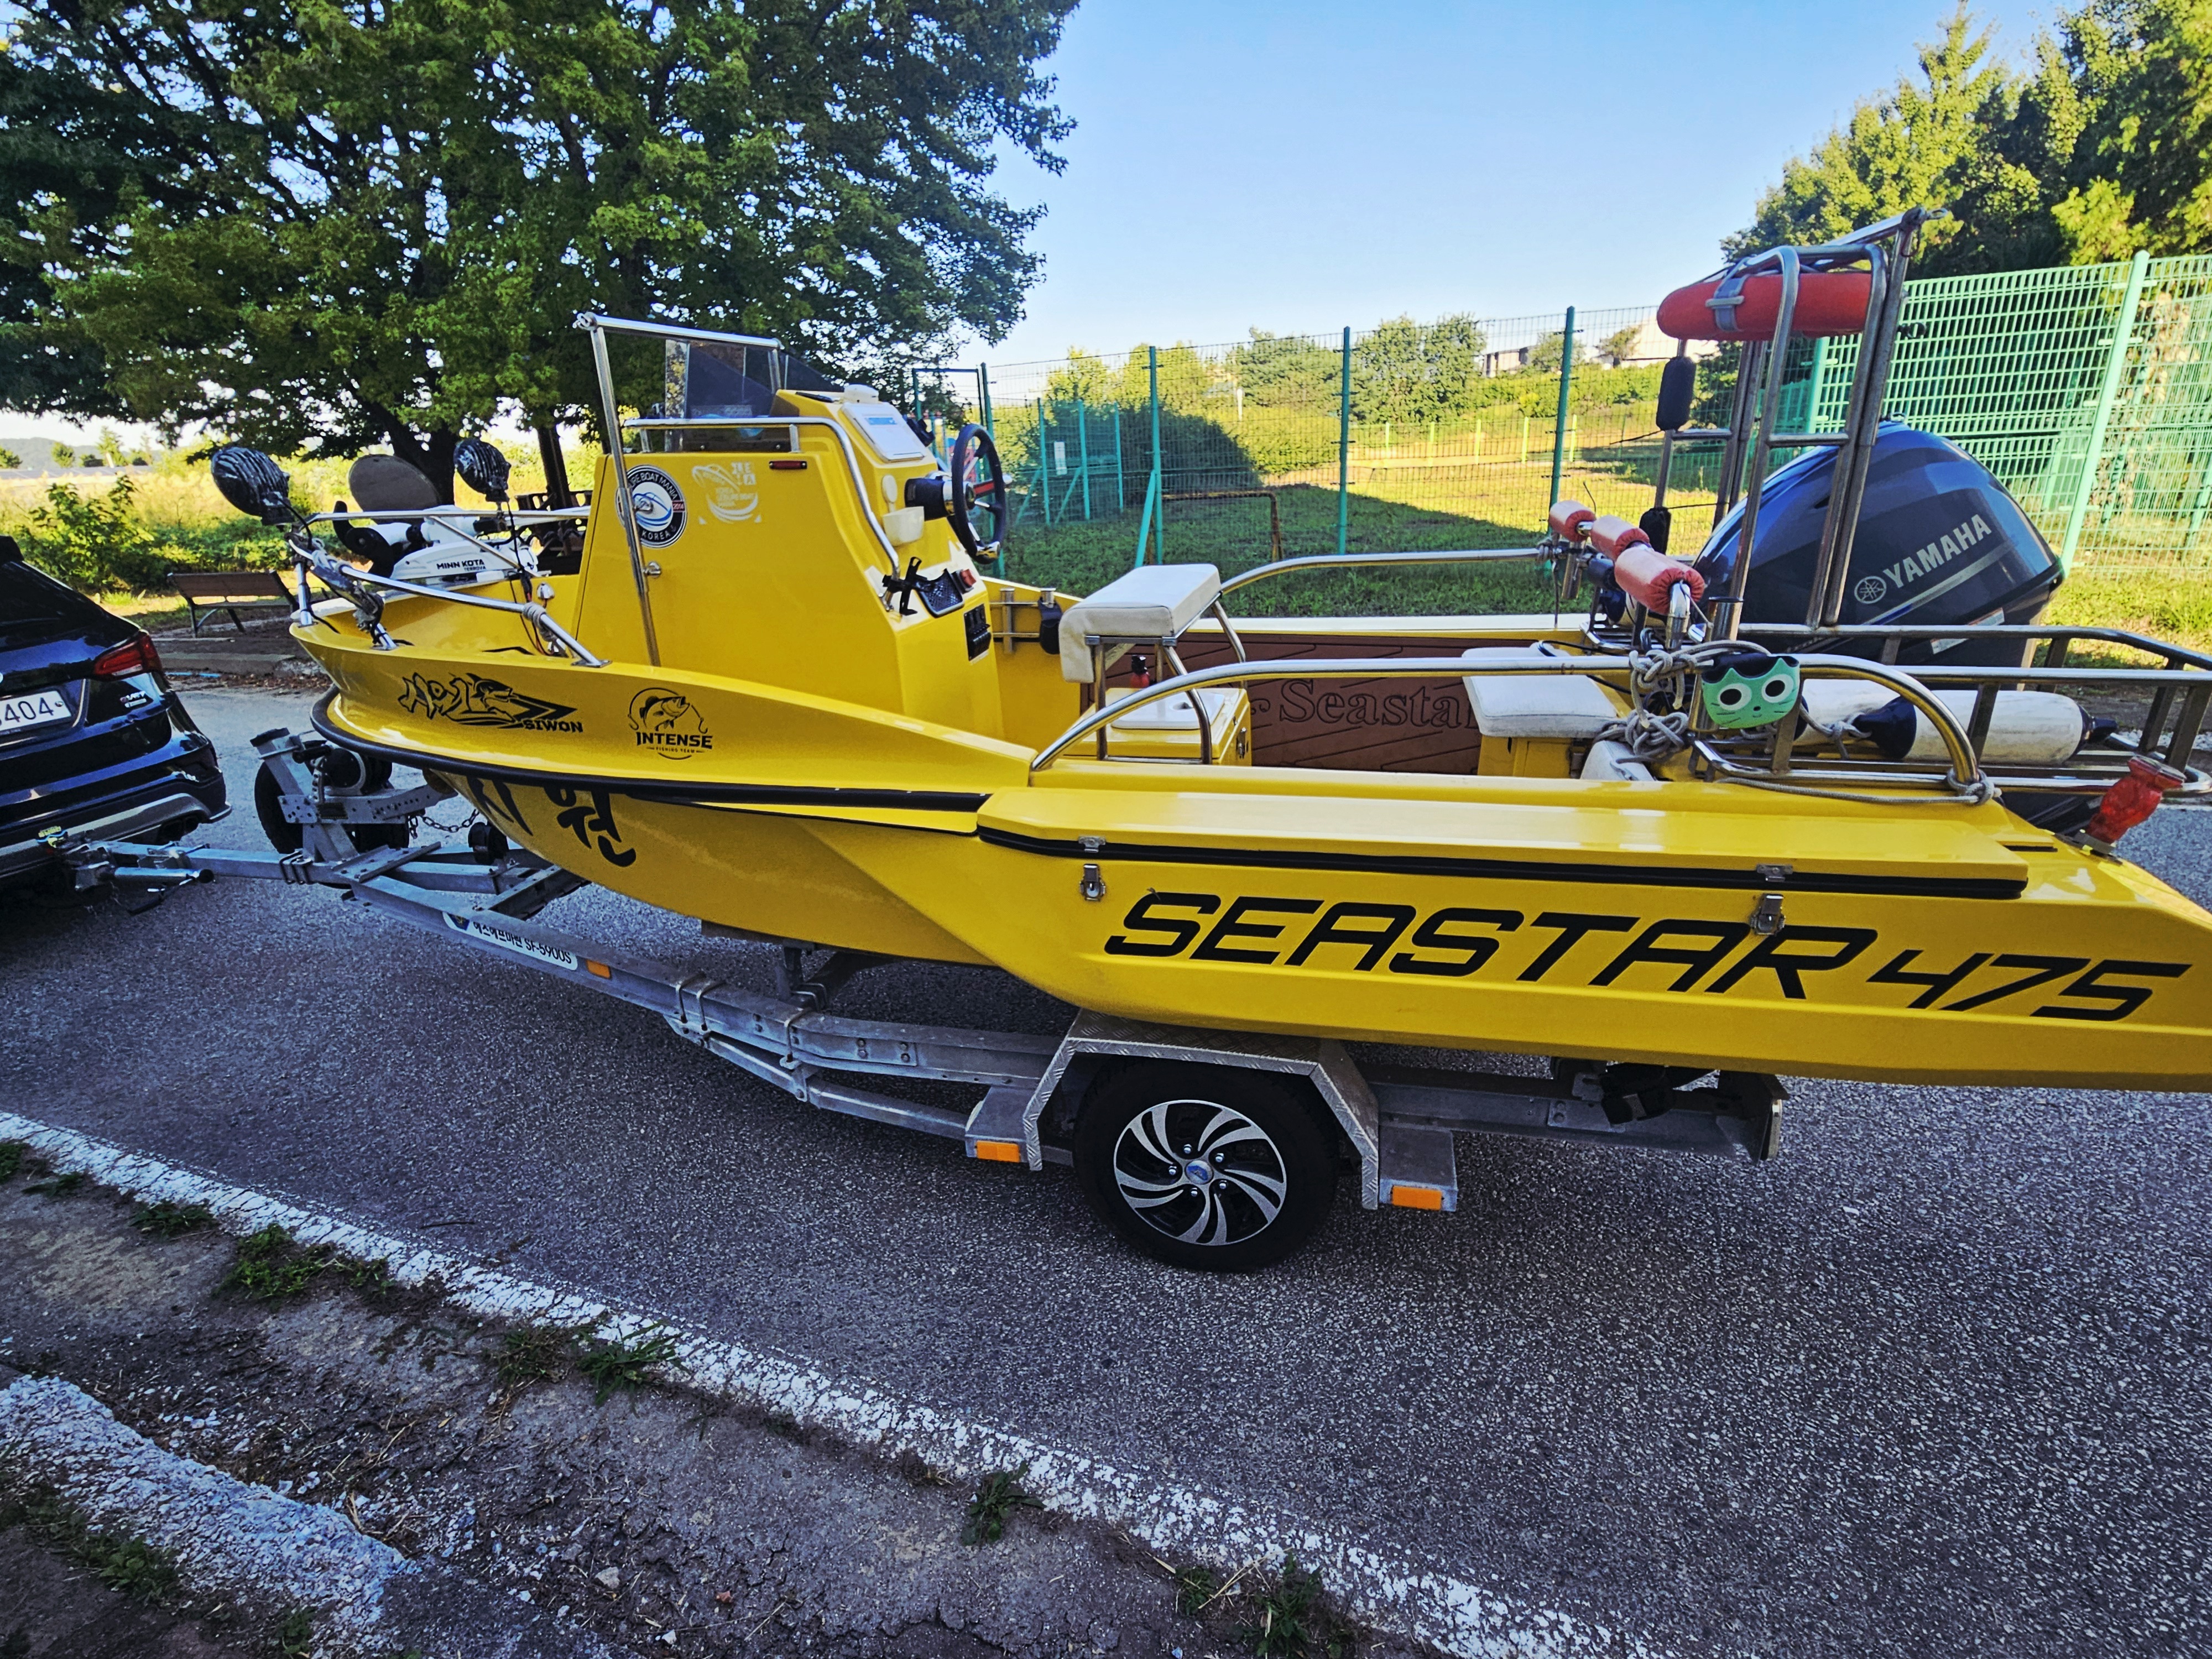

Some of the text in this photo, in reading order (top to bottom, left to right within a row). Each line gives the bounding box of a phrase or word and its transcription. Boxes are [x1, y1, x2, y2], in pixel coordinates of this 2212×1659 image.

[641, 529, 671, 541] KOREA
[1882, 514, 1992, 589] YAMAHA
[436, 559, 485, 570] MINN KOTA
[0, 697, 54, 726] 404
[523, 720, 583, 733] SIWON
[636, 732, 713, 750] INTENSE
[1104, 891, 2193, 1022] SEASTAR 475
